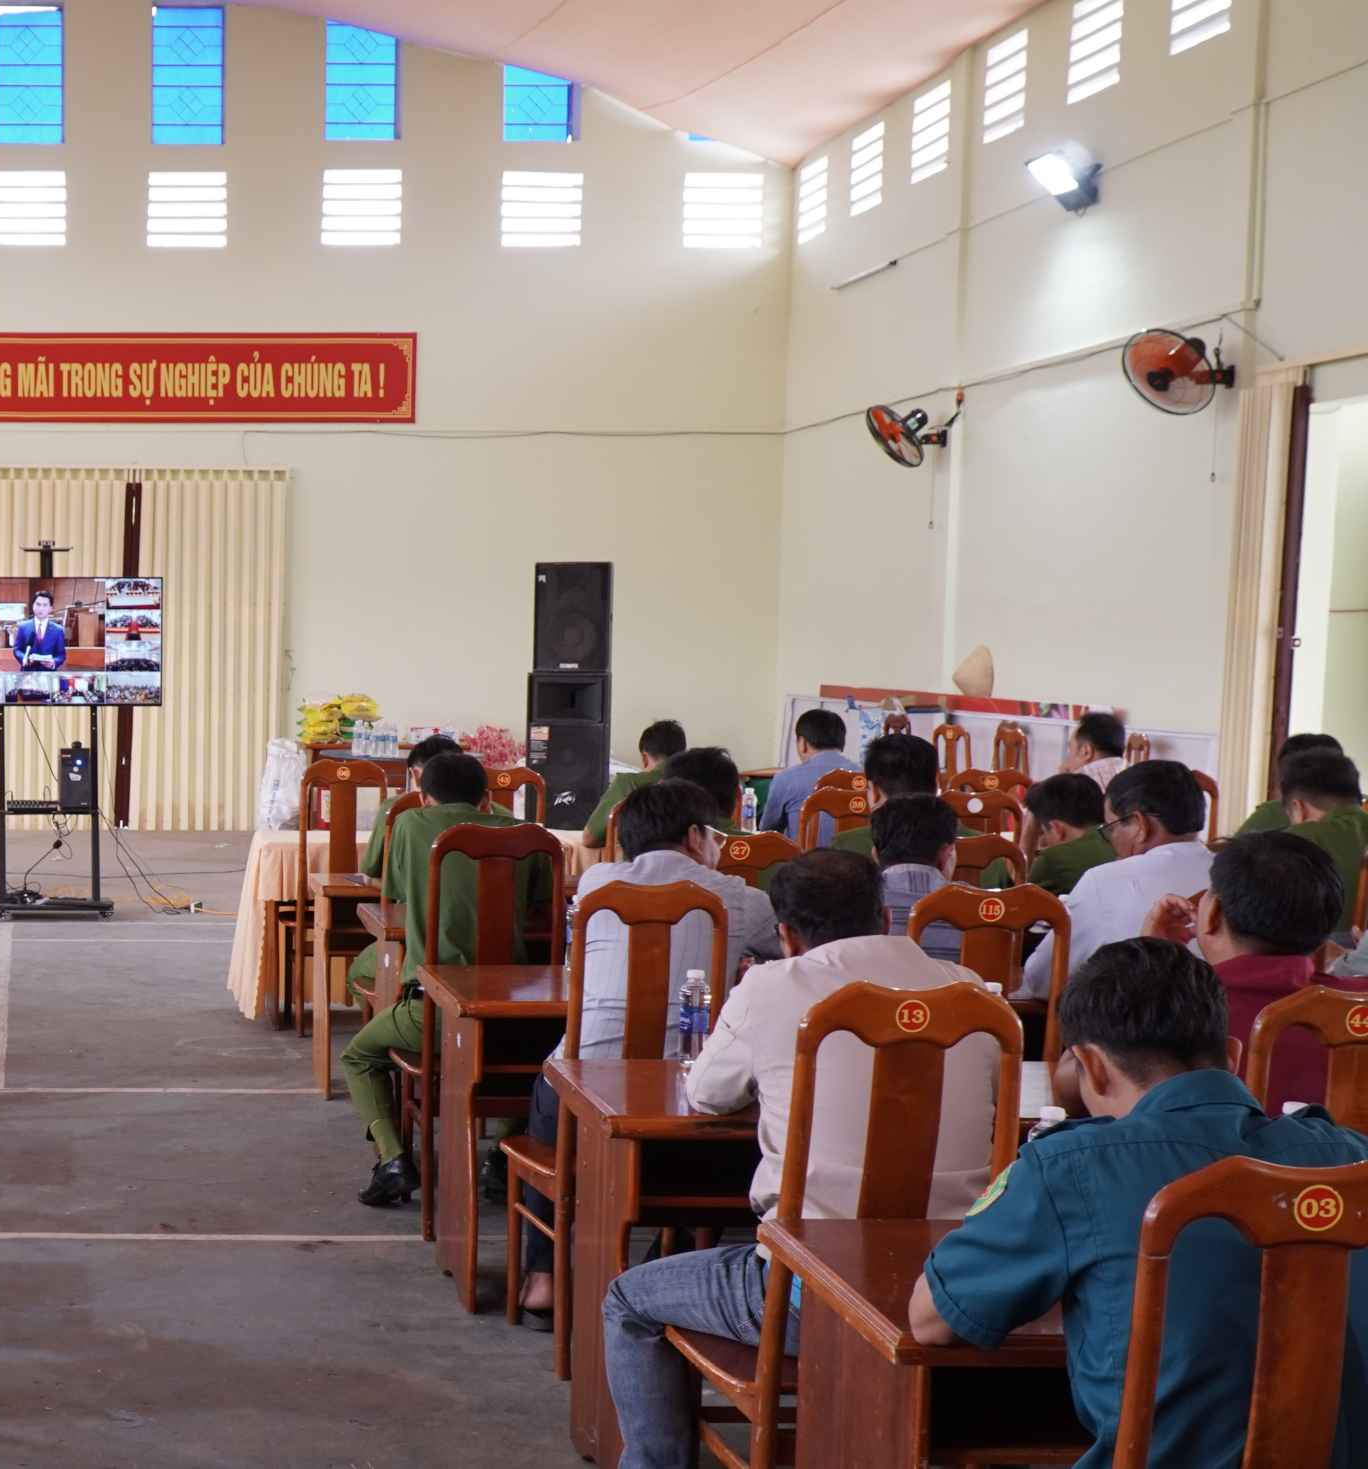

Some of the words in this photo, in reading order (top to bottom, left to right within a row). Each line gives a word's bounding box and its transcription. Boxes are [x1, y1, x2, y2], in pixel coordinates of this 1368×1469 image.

[17, 356, 54, 398] MÃI
[60, 362, 123, 397] TRONG
[129, 360, 157, 405] SỰ
[160, 355, 231, 405] NGHIỆP
[236, 351, 275, 398] CỦA
[281, 356, 346, 398] CHÚNG
[351, 363, 372, 397] TA
[379, 363, 385, 398] !
[732, 846, 747, 855] 27
[983, 905, 1000, 916] 115
[901, 1010, 924, 1023] 13
[1300, 1198, 1337, 1219] 03
